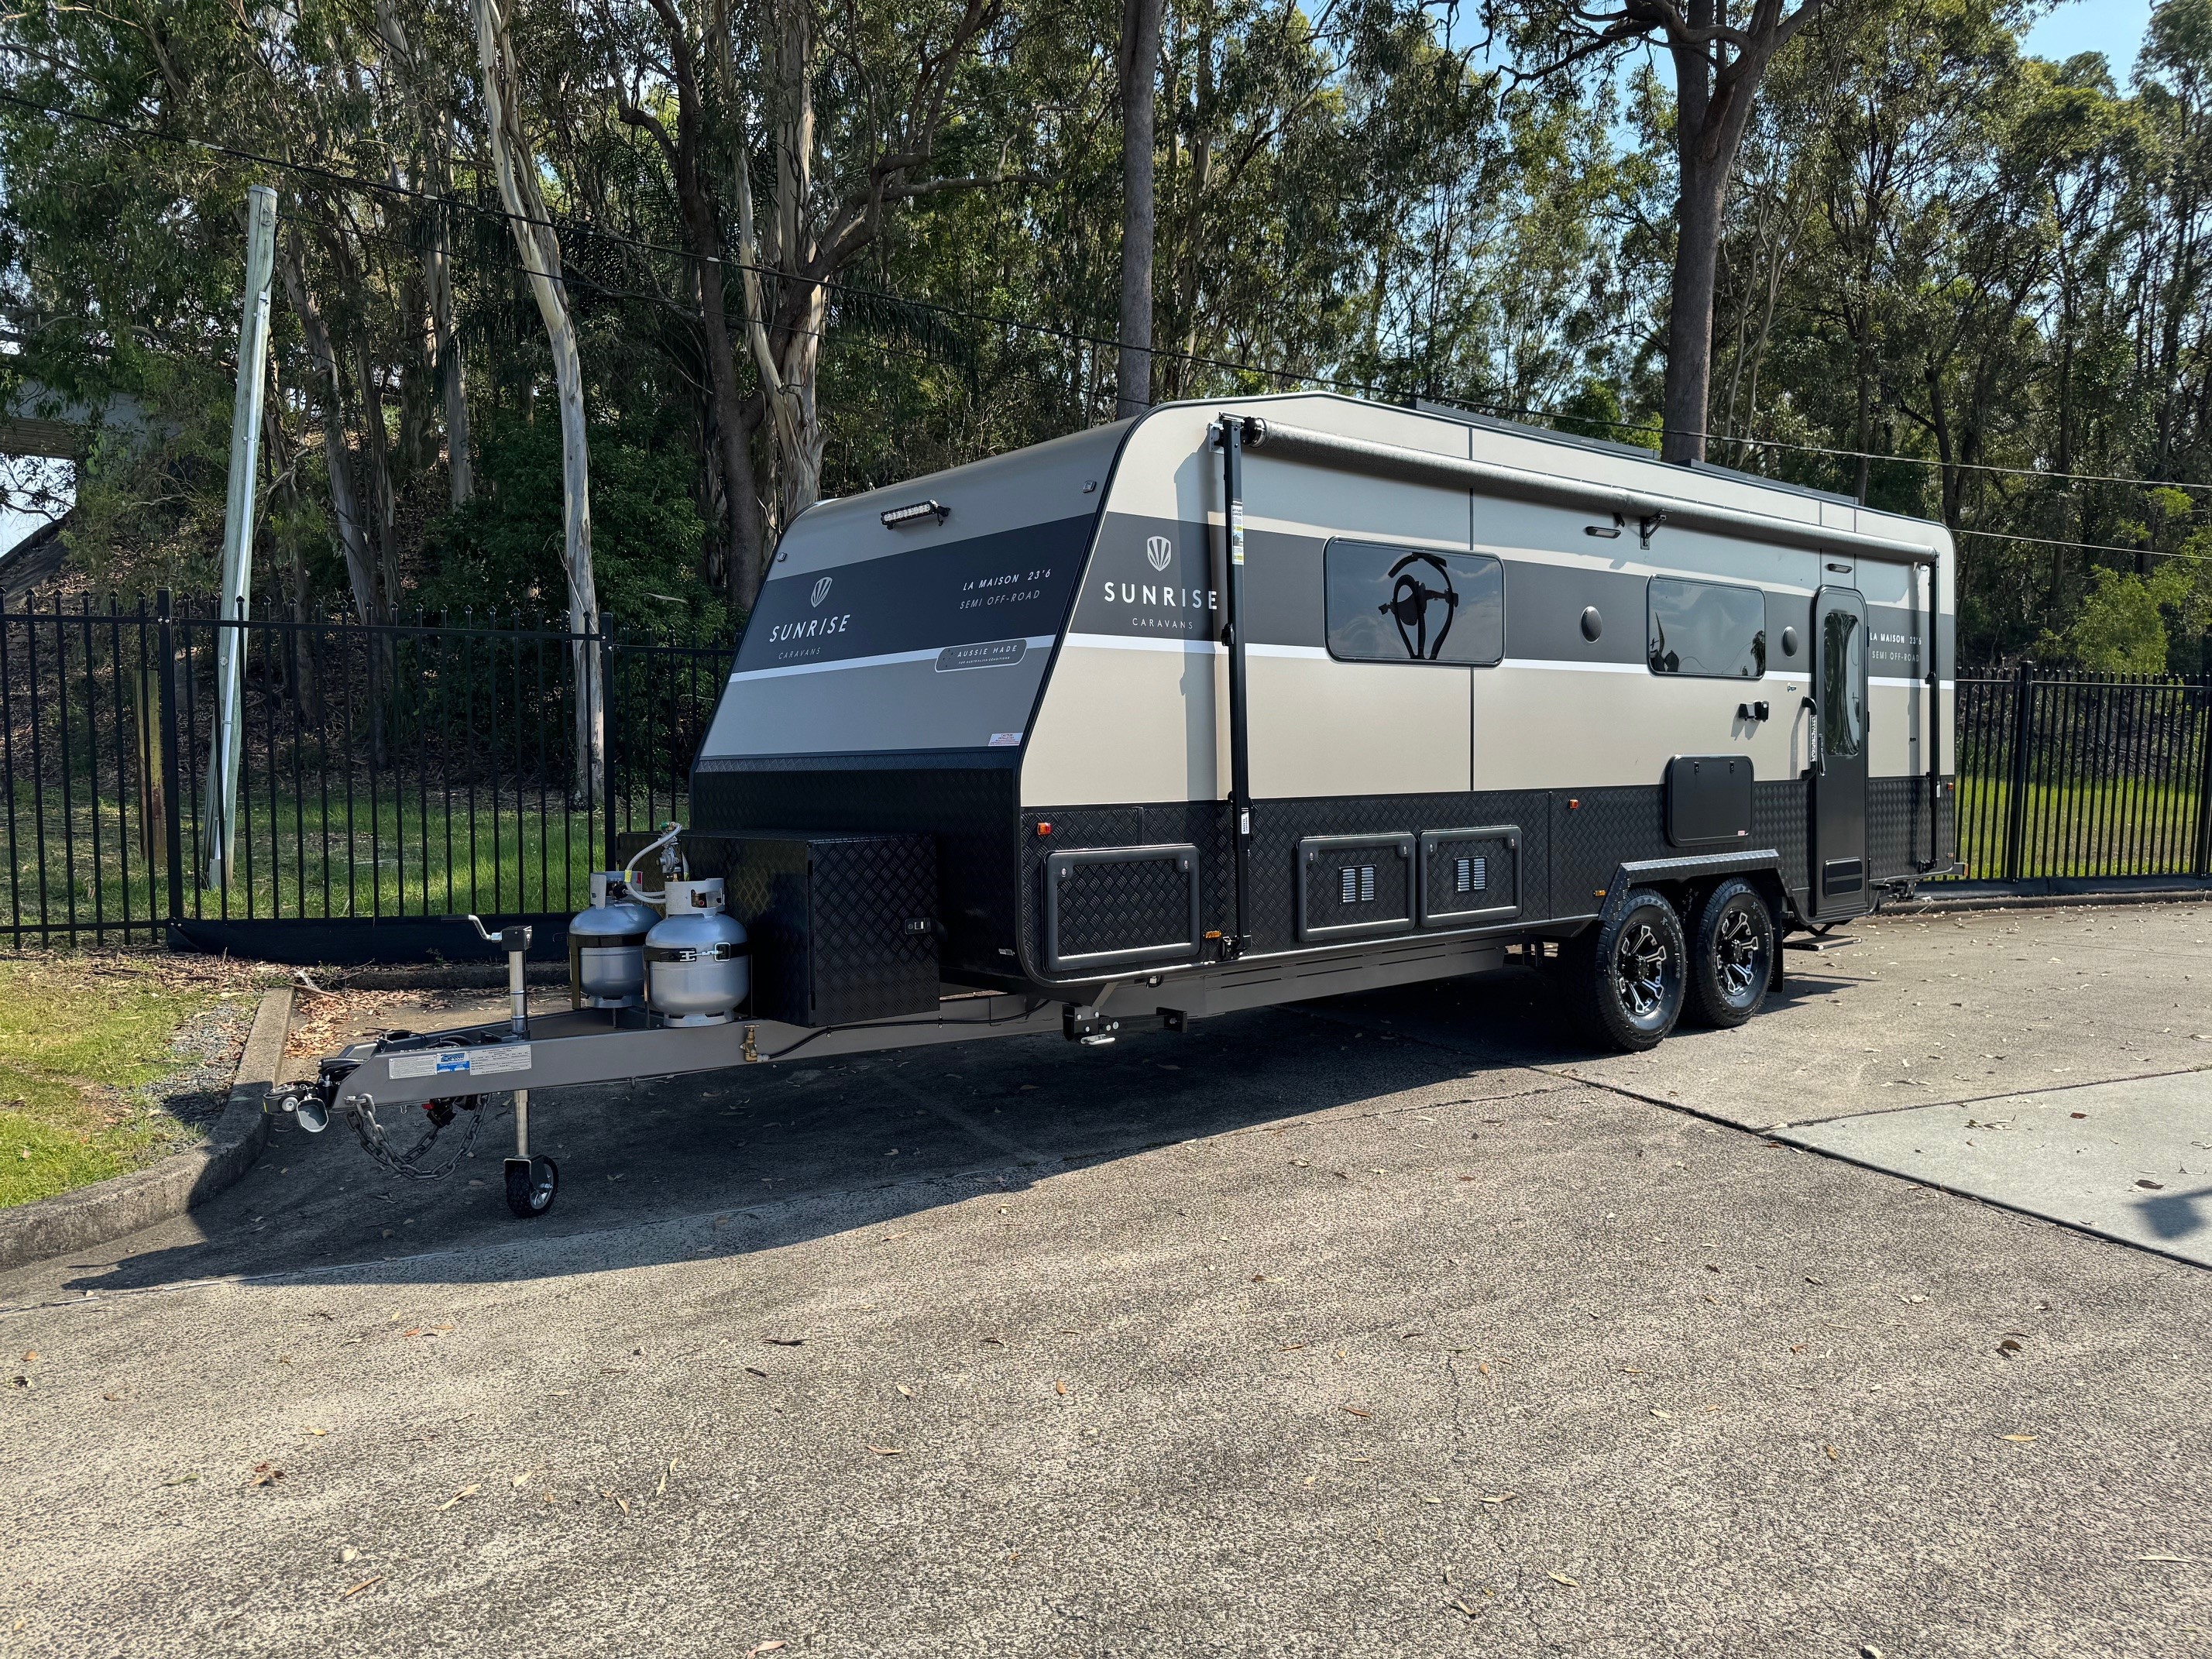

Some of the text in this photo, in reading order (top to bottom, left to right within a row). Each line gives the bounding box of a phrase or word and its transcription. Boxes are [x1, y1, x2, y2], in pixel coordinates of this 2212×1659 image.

[963, 568, 1052, 591] LA MAISON 23'6
[960, 589, 1041, 610] SEMI OFF-ROAD
[1104, 582, 1218, 610] SUNRISE
[769, 614, 850, 642] SUNRISE
[1132, 617, 1193, 629] CARAVANS
[1870, 633, 1877, 641] LA
[1881, 633, 1905, 644] MAISON
[778, 647, 821, 660] CARAVANS
[957, 644, 1017, 658] AUSSIE MADE
[1872, 650, 1919, 662] SEMI OFF-ROAD
